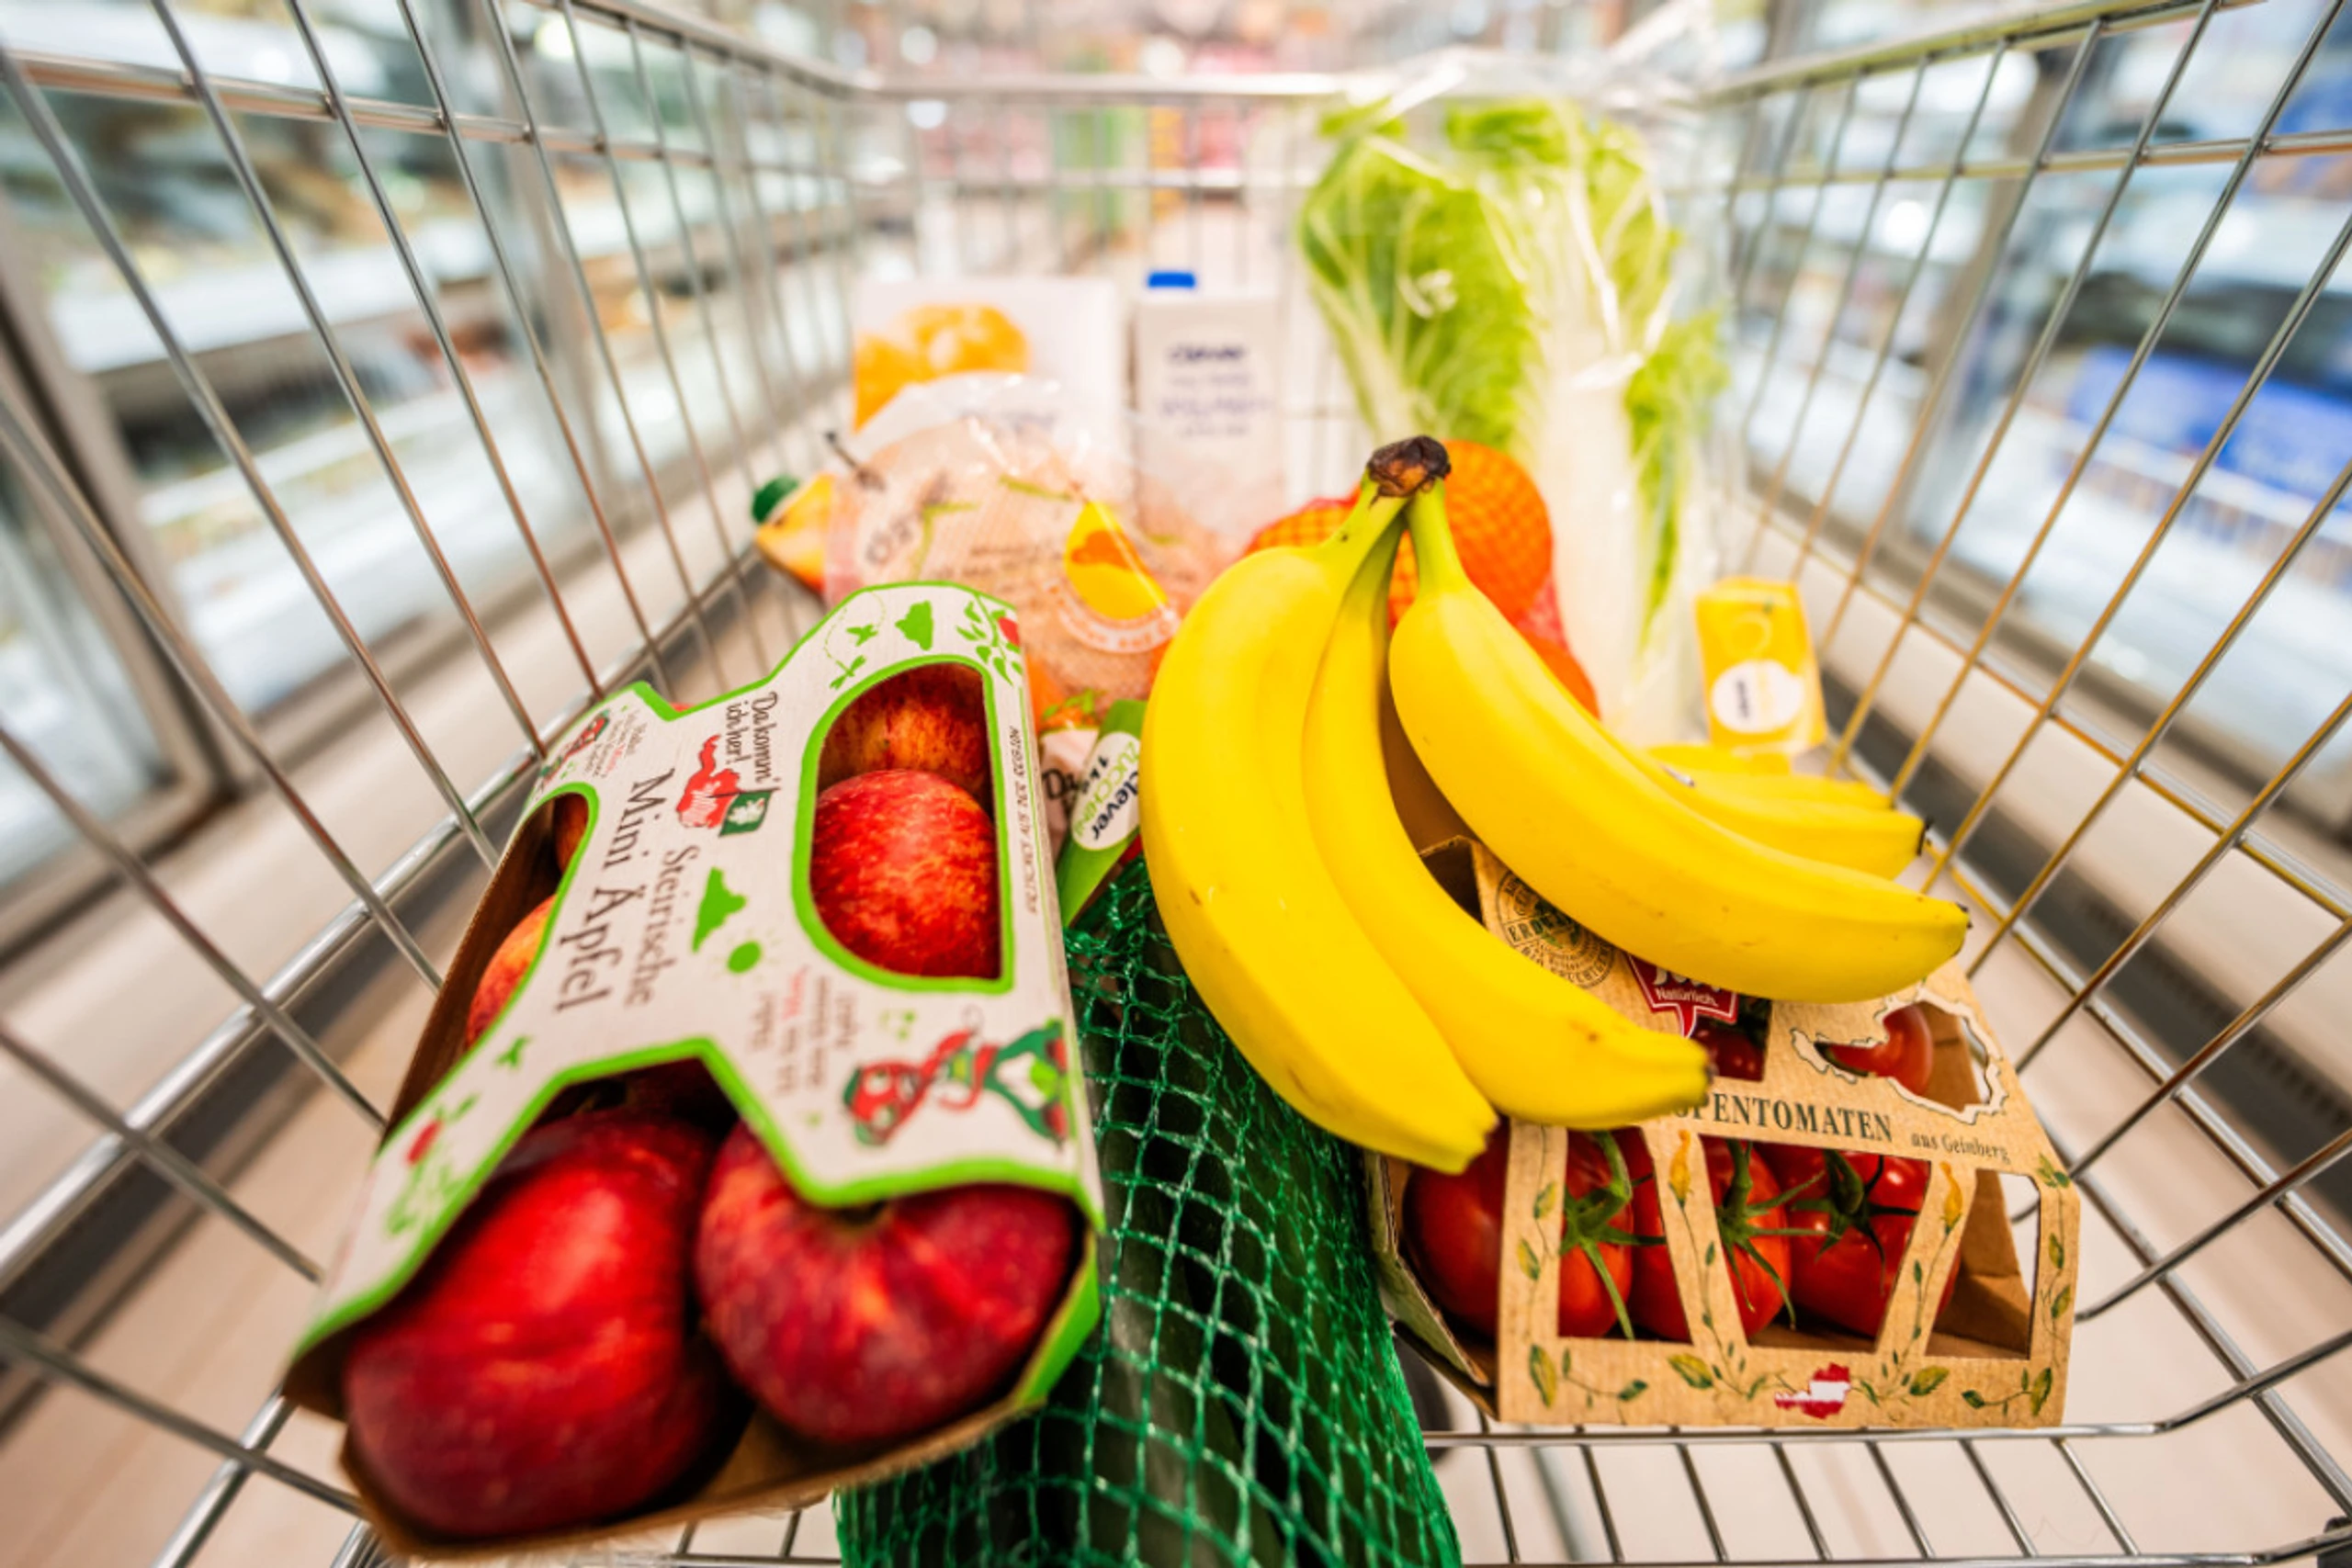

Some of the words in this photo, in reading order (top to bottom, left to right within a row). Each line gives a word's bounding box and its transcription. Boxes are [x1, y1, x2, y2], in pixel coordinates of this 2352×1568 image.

[726, 700, 750, 728] ich
[752, 691, 778, 725] Da
[725, 727, 752, 765] her!
[603, 768, 676, 870] Mini
[624, 844, 701, 1008] Steirische
[554, 883, 648, 1012] Äpfel
[1911, 1132, 1939, 1151] aus
